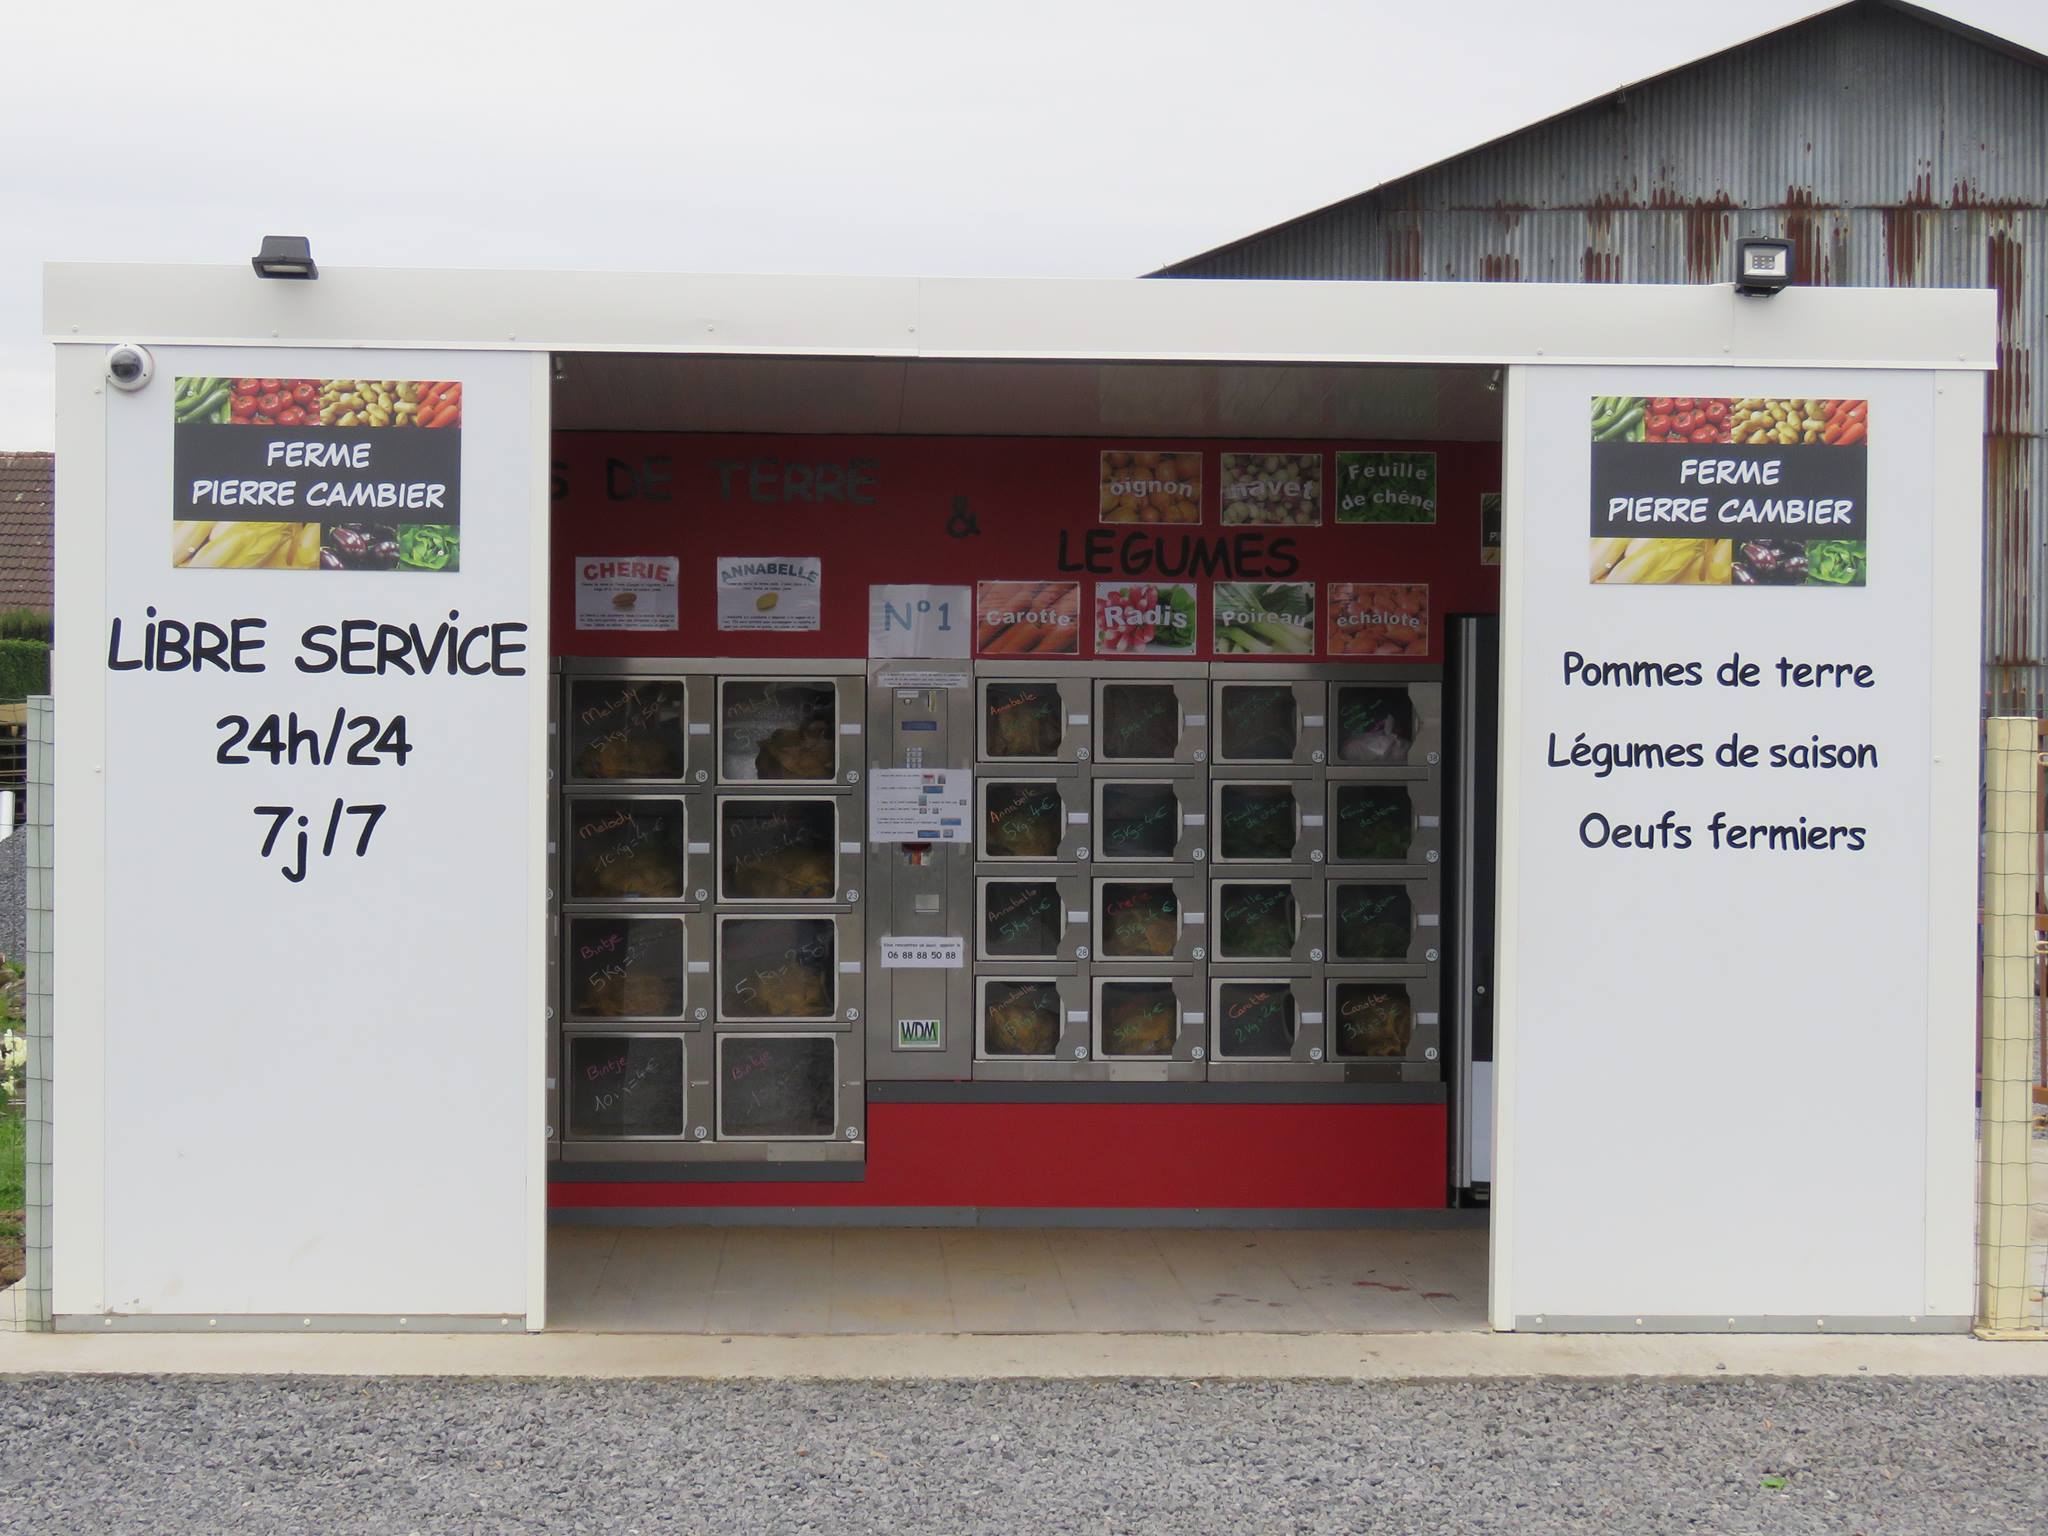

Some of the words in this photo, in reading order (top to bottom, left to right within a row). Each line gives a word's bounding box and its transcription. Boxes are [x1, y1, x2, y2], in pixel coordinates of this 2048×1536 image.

[267, 441, 371, 469] FERME
[606, 456, 672, 501] DE
[706, 456, 880, 504] TERRE
[1348, 462, 1428, 480] Feuille
[1680, 458, 1781, 485] FERME
[192, 480, 297, 507] PIERRE
[306, 482, 446, 508] CAMBIER
[1110, 477, 1193, 497] oignon
[1342, 494, 1366, 510] de
[1608, 497, 1709, 523] PIERRE
[1718, 499, 1853, 525] CAMBIER
[1056, 528, 1300, 578] LEGUMES
[583, 562, 670, 582] CHERIE
[721, 563, 819, 583] ANNABELLE
[986, 608, 1071, 626] Carotte
[1104, 604, 1188, 629] Radis
[1221, 608, 1306, 628] Poireau
[1563, 651, 1703, 687] Pommes
[1716, 652, 1761, 687] de
[1775, 657, 1875, 688] terre
[216, 706, 413, 766] 24h/24
[1548, 732, 1704, 778] Légumes
[1715, 732, 1759, 768] de
[1769, 735, 1878, 769] saison
[253, 797, 387, 883] 7j/7
[1579, 811, 1692, 849] Oeufs
[1707, 811, 1867, 851] fermiers
[887, 951, 899, 959] 06
[902, 951, 913, 959] 88
[916, 951, 928, 959] 88
[931, 951, 942, 959] 50
[945, 951, 956, 959] 88
[900, 1021, 937, 1041] WDM
